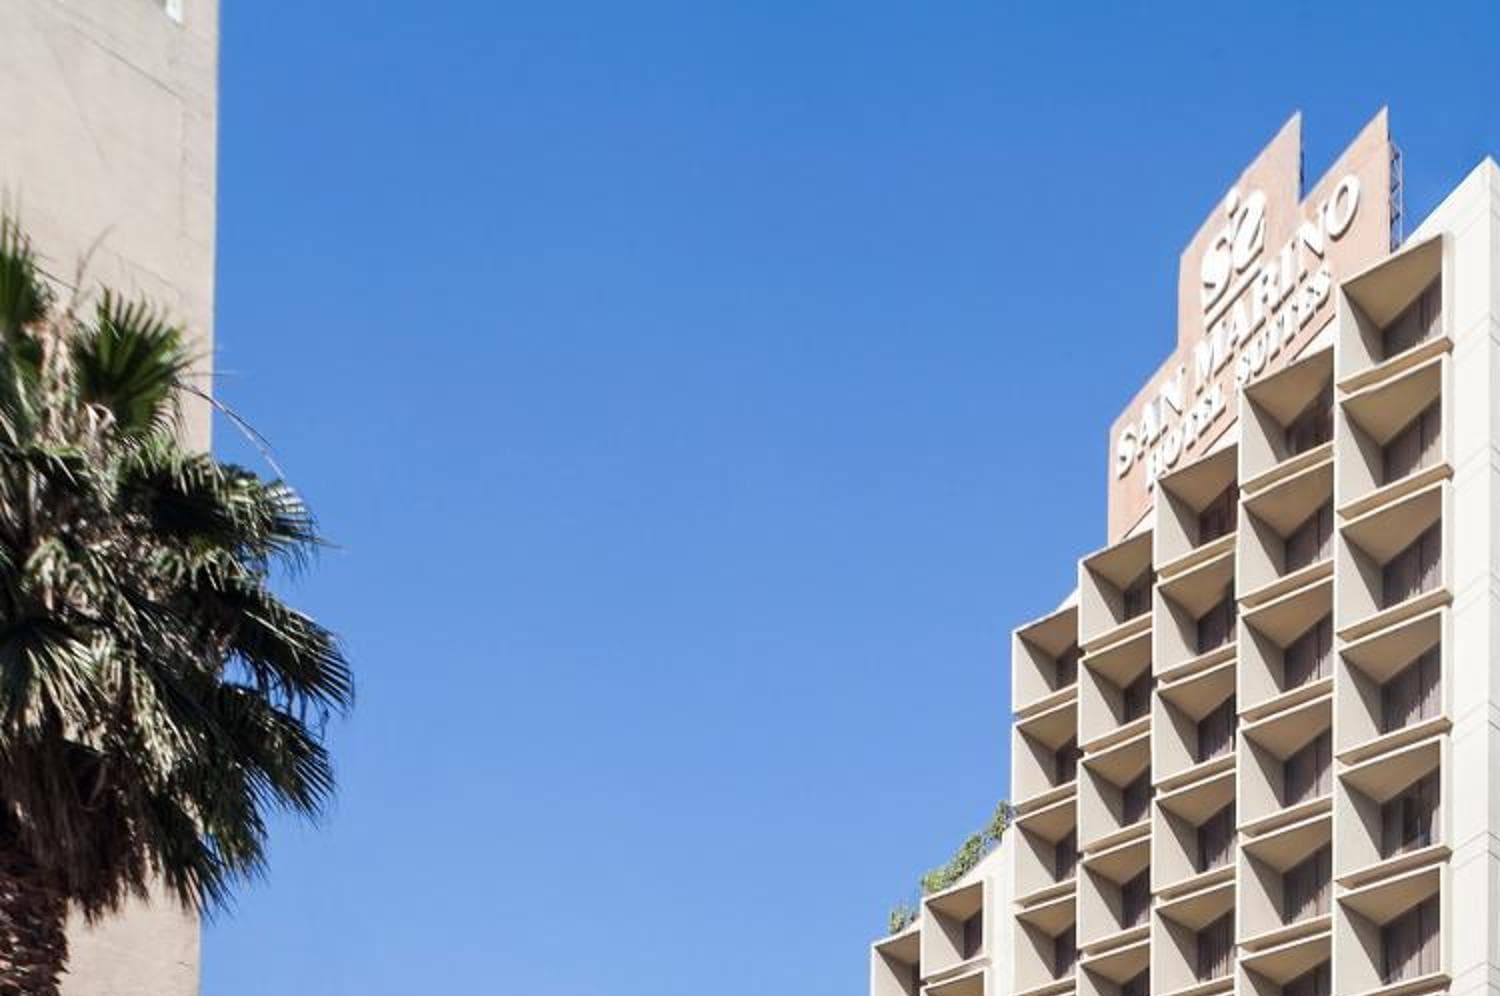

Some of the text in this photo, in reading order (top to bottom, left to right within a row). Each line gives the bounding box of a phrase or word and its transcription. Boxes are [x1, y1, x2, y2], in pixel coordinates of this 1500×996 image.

[1116, 174, 1360, 480] SAN MARINO
[1146, 261, 1331, 494] HOTEL SUITES
